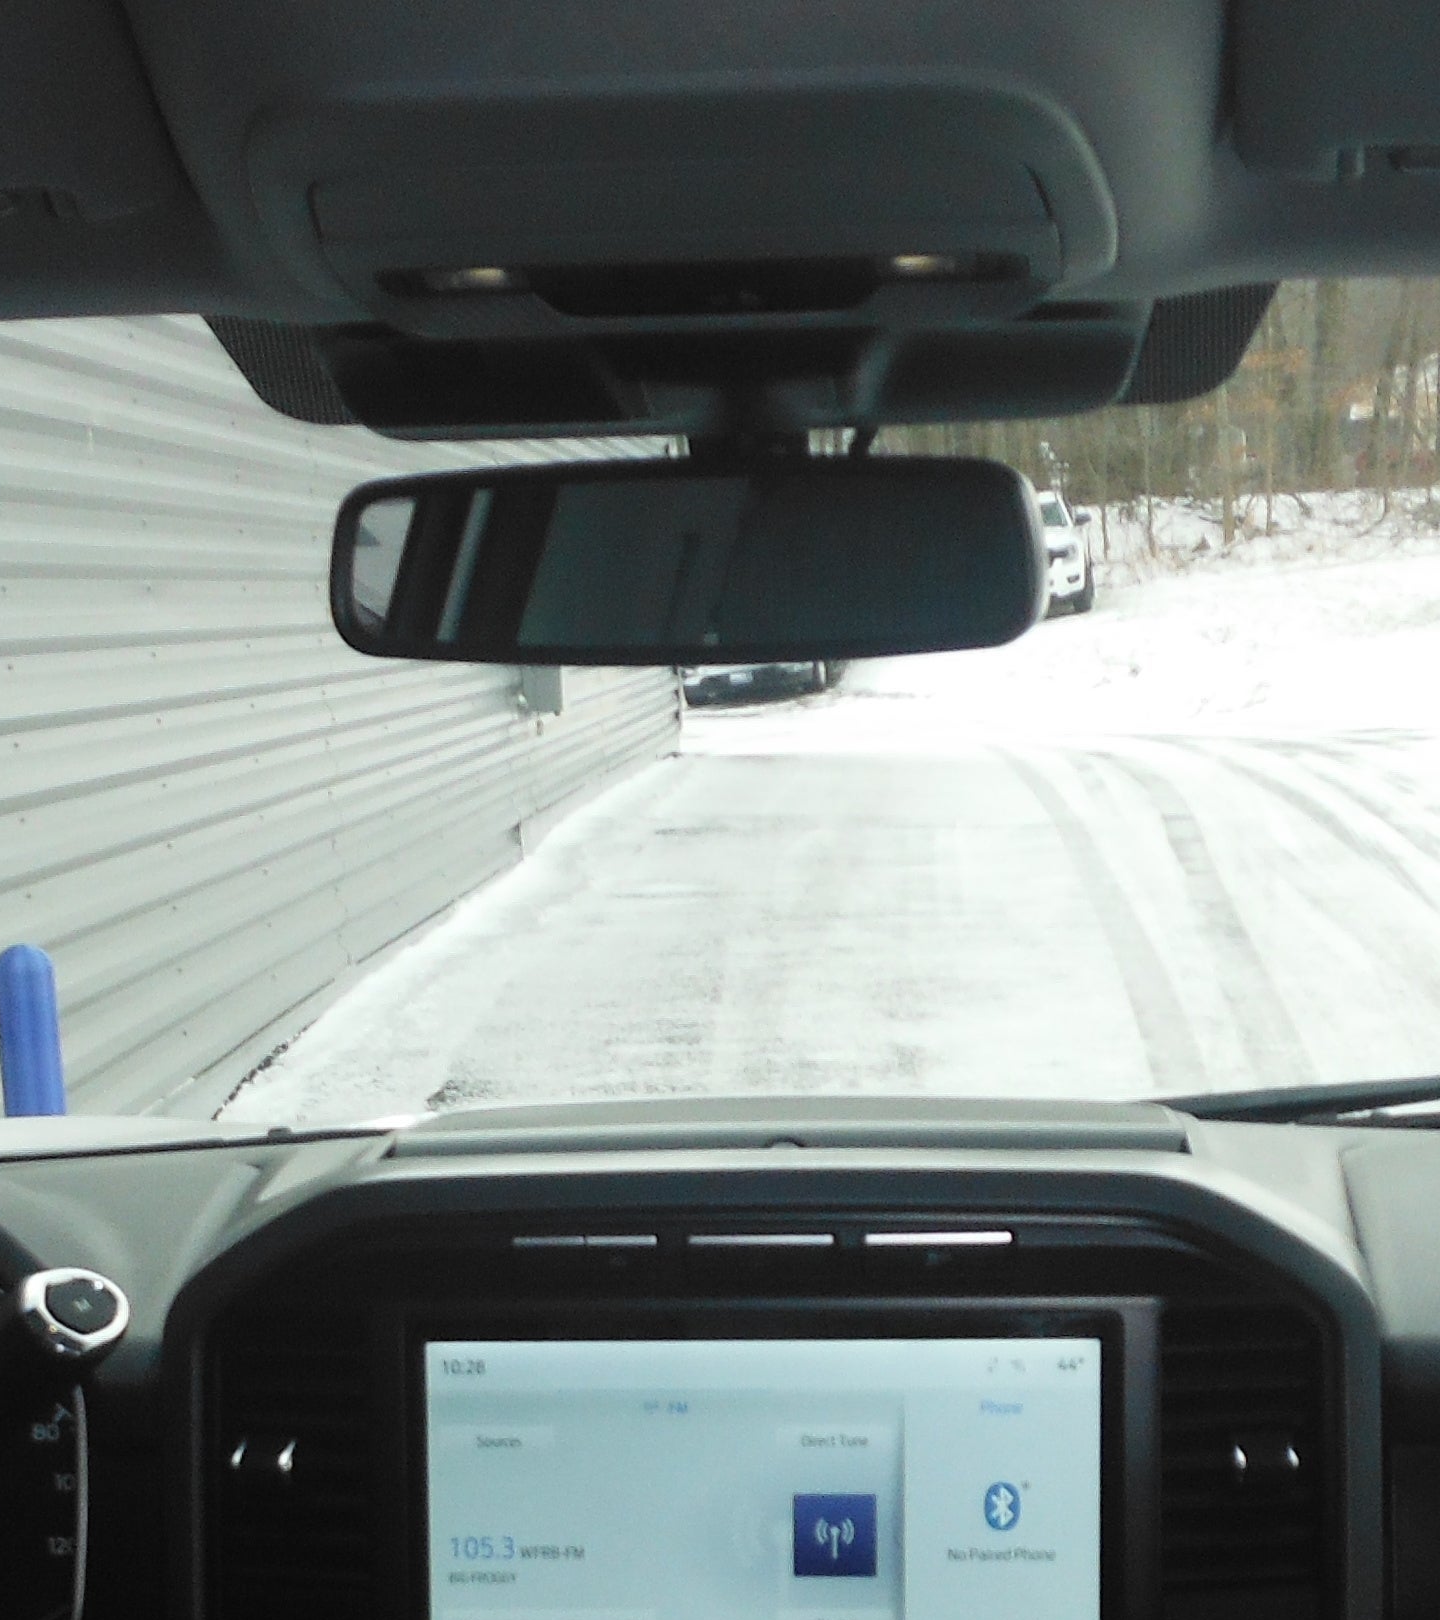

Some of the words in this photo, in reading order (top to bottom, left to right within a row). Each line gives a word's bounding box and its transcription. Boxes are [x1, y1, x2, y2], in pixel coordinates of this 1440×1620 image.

[442, 1359, 486, 1376] 10:28
[980, 1399, 1024, 1416] Phone
[800, 1432, 837, 1448] Direct
[839, 1432, 869, 1448] Tune
[449, 1535, 516, 1560] 105.3
[947, 1547, 967, 1562] No
[969, 1547, 1012, 1562] Paired
[1013, 1547, 1057, 1562] Phone
